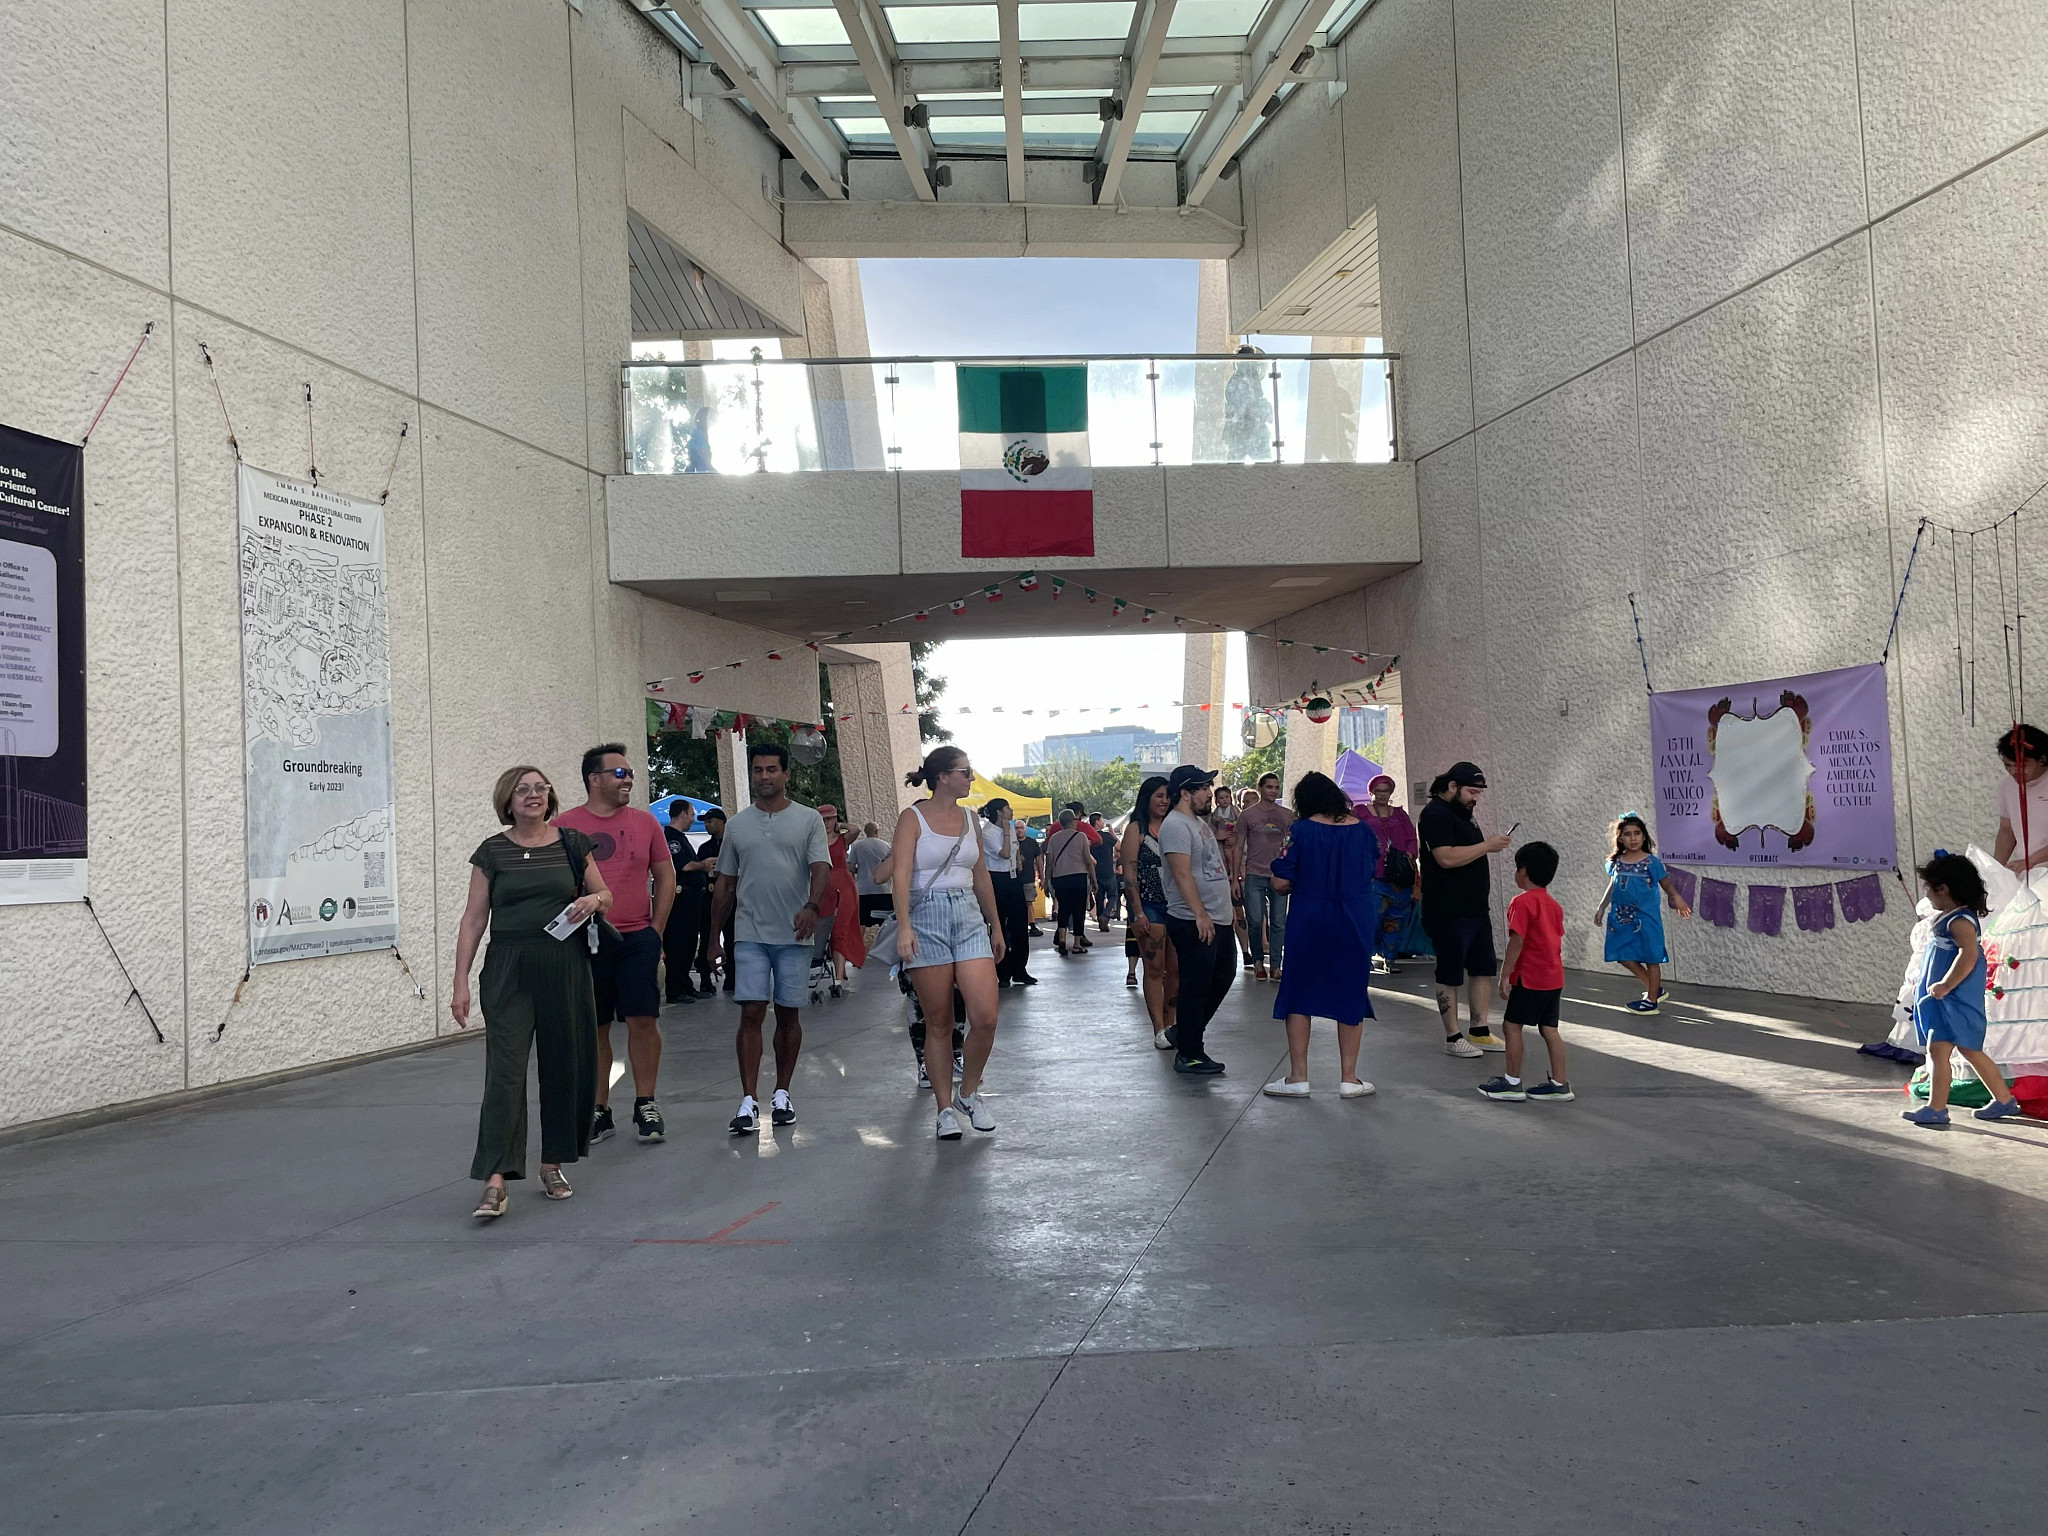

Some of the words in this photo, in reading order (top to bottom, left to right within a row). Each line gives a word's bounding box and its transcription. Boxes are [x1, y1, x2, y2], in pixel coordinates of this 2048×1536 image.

[0, 465, 10, 475] to
[11, 468, 27, 479] the
[276, 481, 298, 493] EMMA
[301, 487, 308, 495] S.
[311, 490, 352, 508] BARRIENTOS
[0, 492, 36, 508] Cultural
[37, 500, 70, 516] Center!
[263, 491, 289, 505] MEXICAN
[290, 498, 318, 512] AMERICAN
[318, 505, 343, 519] CULTURAL
[344, 512, 362, 524] CENTER
[299, 510, 326, 526] PHASE
[327, 517, 333, 527] 2
[258, 515, 308, 538] EXPANSION
[310, 528, 317, 539] &
[320, 530, 370, 552] RENOVATION
[5, 612, 26, 620] events
[25, 675, 44, 683] MACC
[2, 700, 32, 709] 10am-5pm
[1829, 730, 1856, 742] EMMA
[1859, 729, 1868, 740] S.
[1668, 736, 1693, 751] 15TH
[1820, 741, 1880, 755] BARRIENTOS
[1660, 753, 1704, 768] ANNUAL
[1829, 755, 1872, 768] MEXICAN
[283, 760, 362, 777] Groundbreaking
[1827, 769, 1876, 781] AMERICAN
[1669, 769, 1694, 784] VIVA
[309, 782, 326, 792] Early
[326, 782, 345, 792] 2023!
[1663, 785, 1704, 800] MEXICO
[1826, 782, 1877, 794] CULTURAL
[1833, 795, 1872, 807] CENTER
[1669, 802, 1699, 816] 2022
[1749, 854, 1779, 863] @ESBMACC
